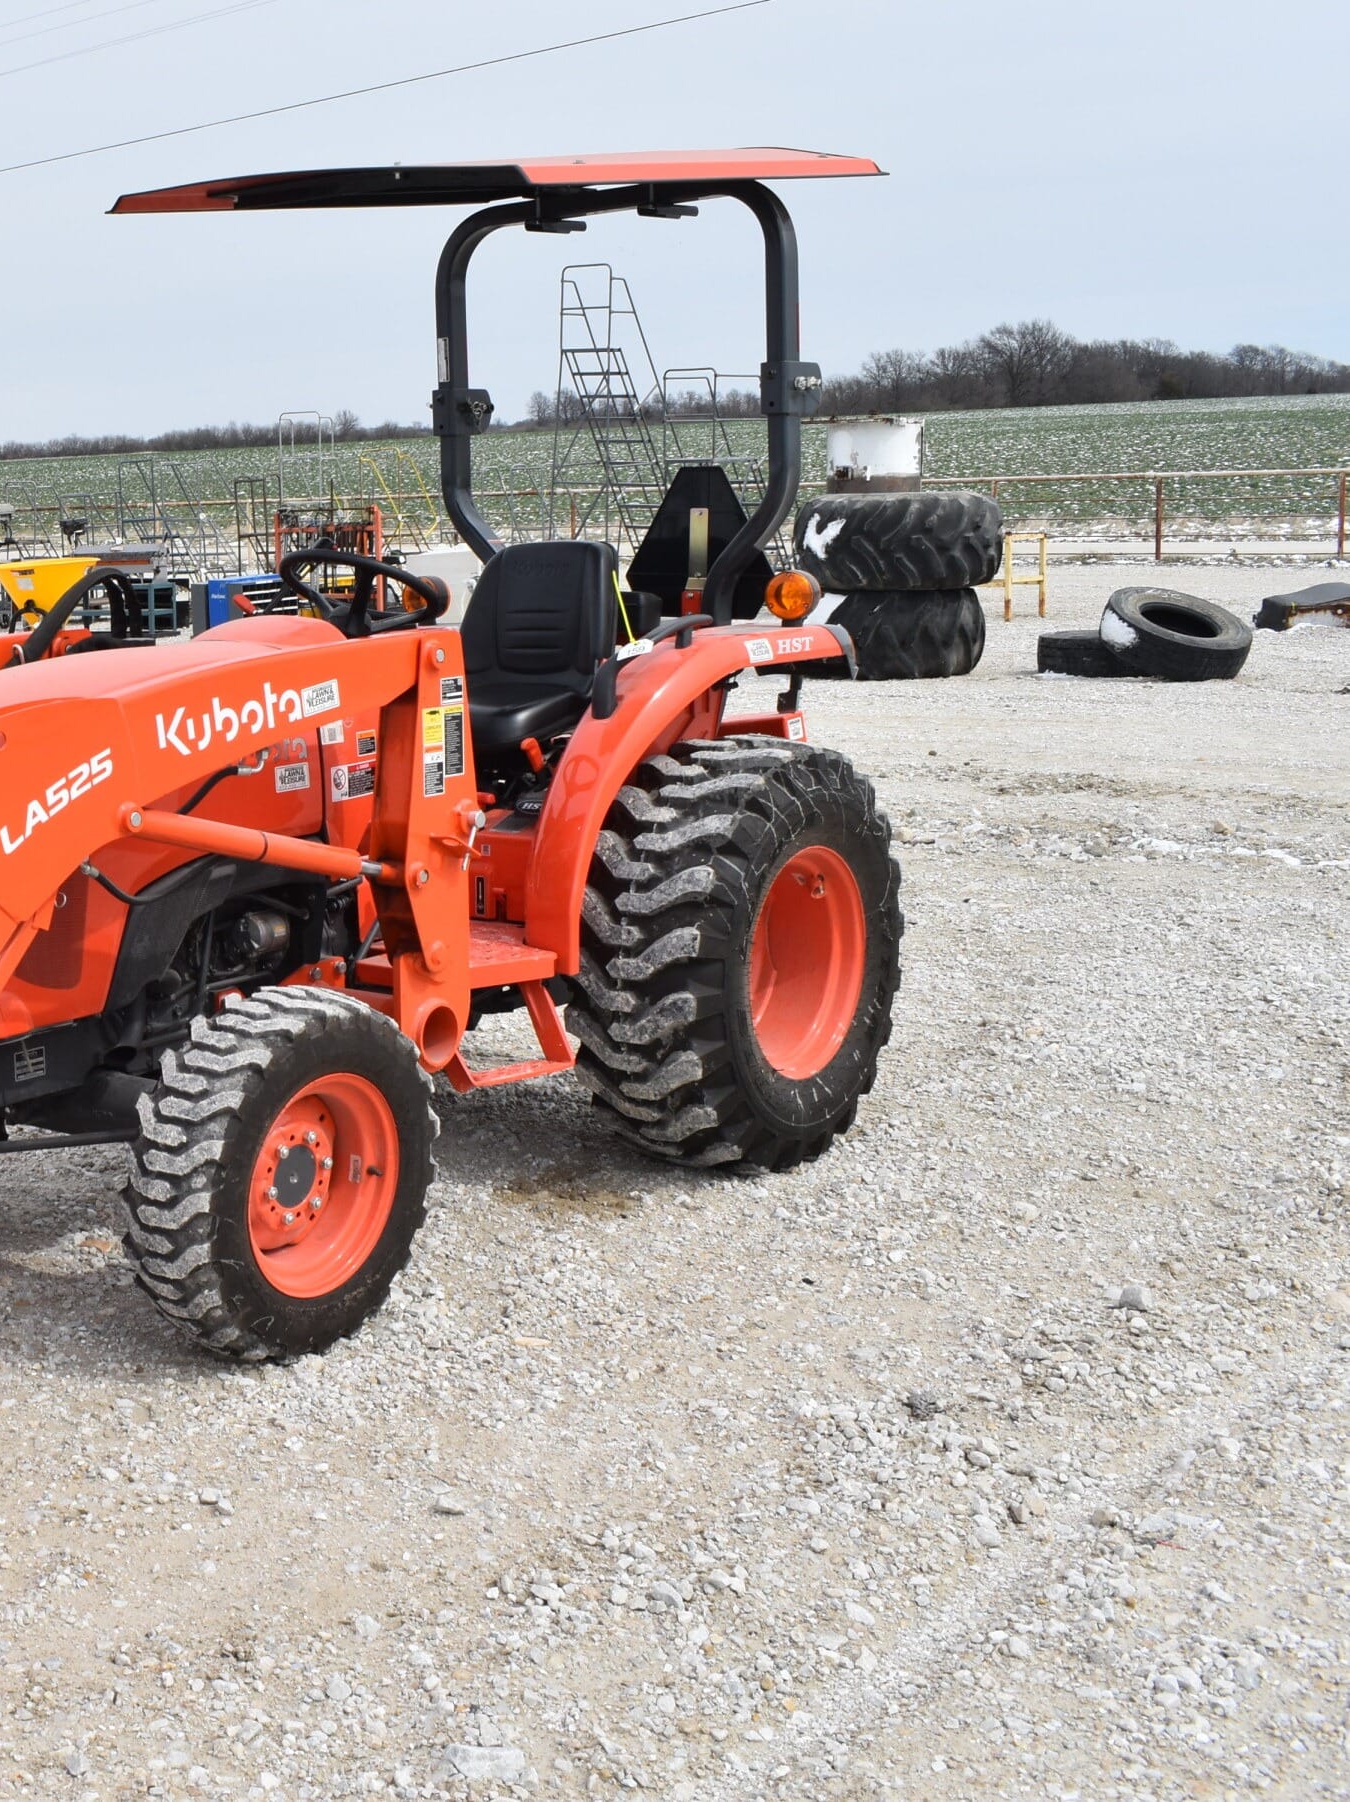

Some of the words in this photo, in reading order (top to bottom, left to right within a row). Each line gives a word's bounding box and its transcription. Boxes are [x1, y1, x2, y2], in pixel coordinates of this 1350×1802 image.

[776, 637, 814, 654] HST
[156, 681, 303, 755] Kubota
[0, 748, 114, 855] LA525
